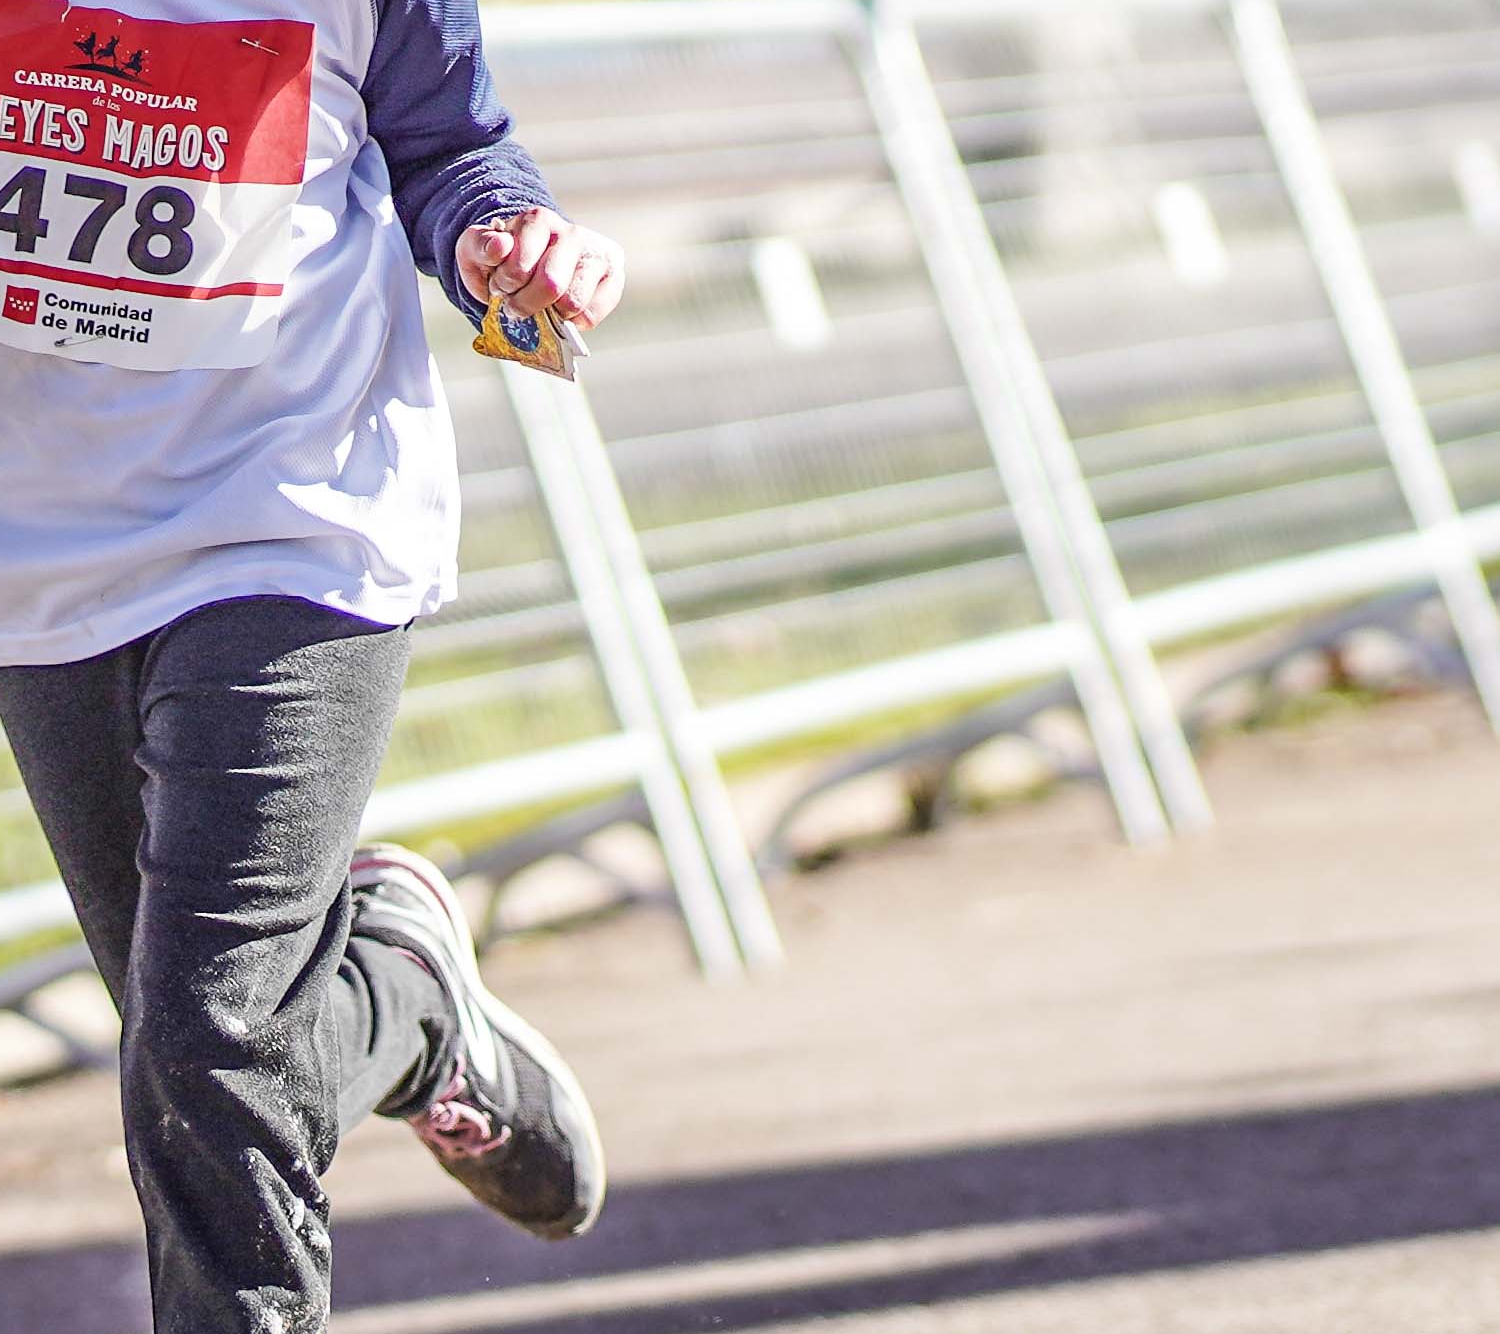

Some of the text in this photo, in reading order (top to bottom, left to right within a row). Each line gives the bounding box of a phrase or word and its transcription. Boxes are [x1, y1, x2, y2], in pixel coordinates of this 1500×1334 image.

[14, 69, 198, 112] CARRERA POPULAR
[92, 96, 121, 112] de los
[102, 114, 229, 171] MAGOS
[44, 293, 153, 322] Comunidad
[41, 314, 150, 344] de Madrid
